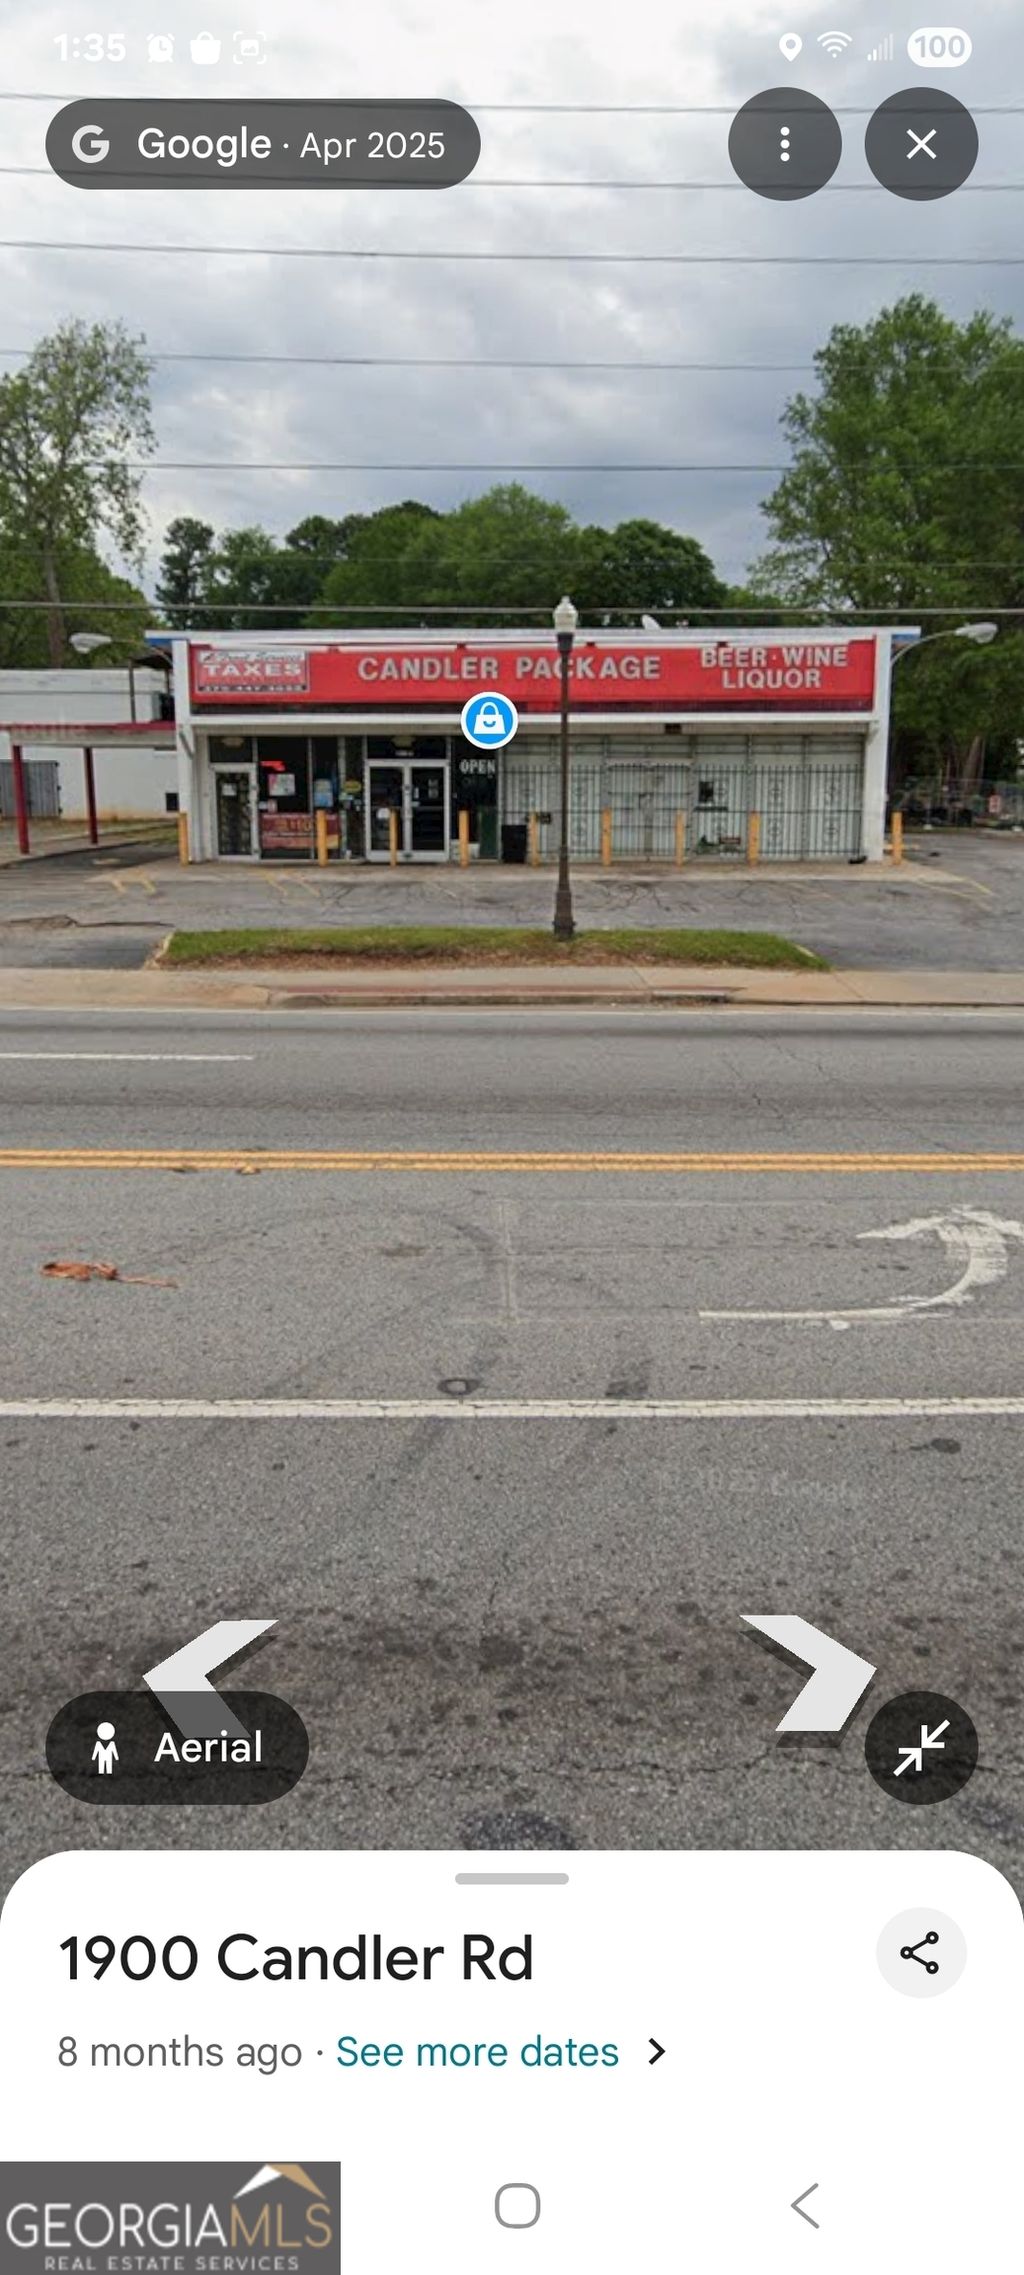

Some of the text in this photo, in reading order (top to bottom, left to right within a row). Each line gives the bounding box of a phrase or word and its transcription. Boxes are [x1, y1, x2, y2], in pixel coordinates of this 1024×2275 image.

[358, 656, 661, 680] CANDLER PACKAGE
[702, 647, 848, 668] BEER WINE
[203, 663, 300, 676] TAXES
[722, 668, 821, 689] LIQUOR
[459, 759, 496, 774] OPEN
